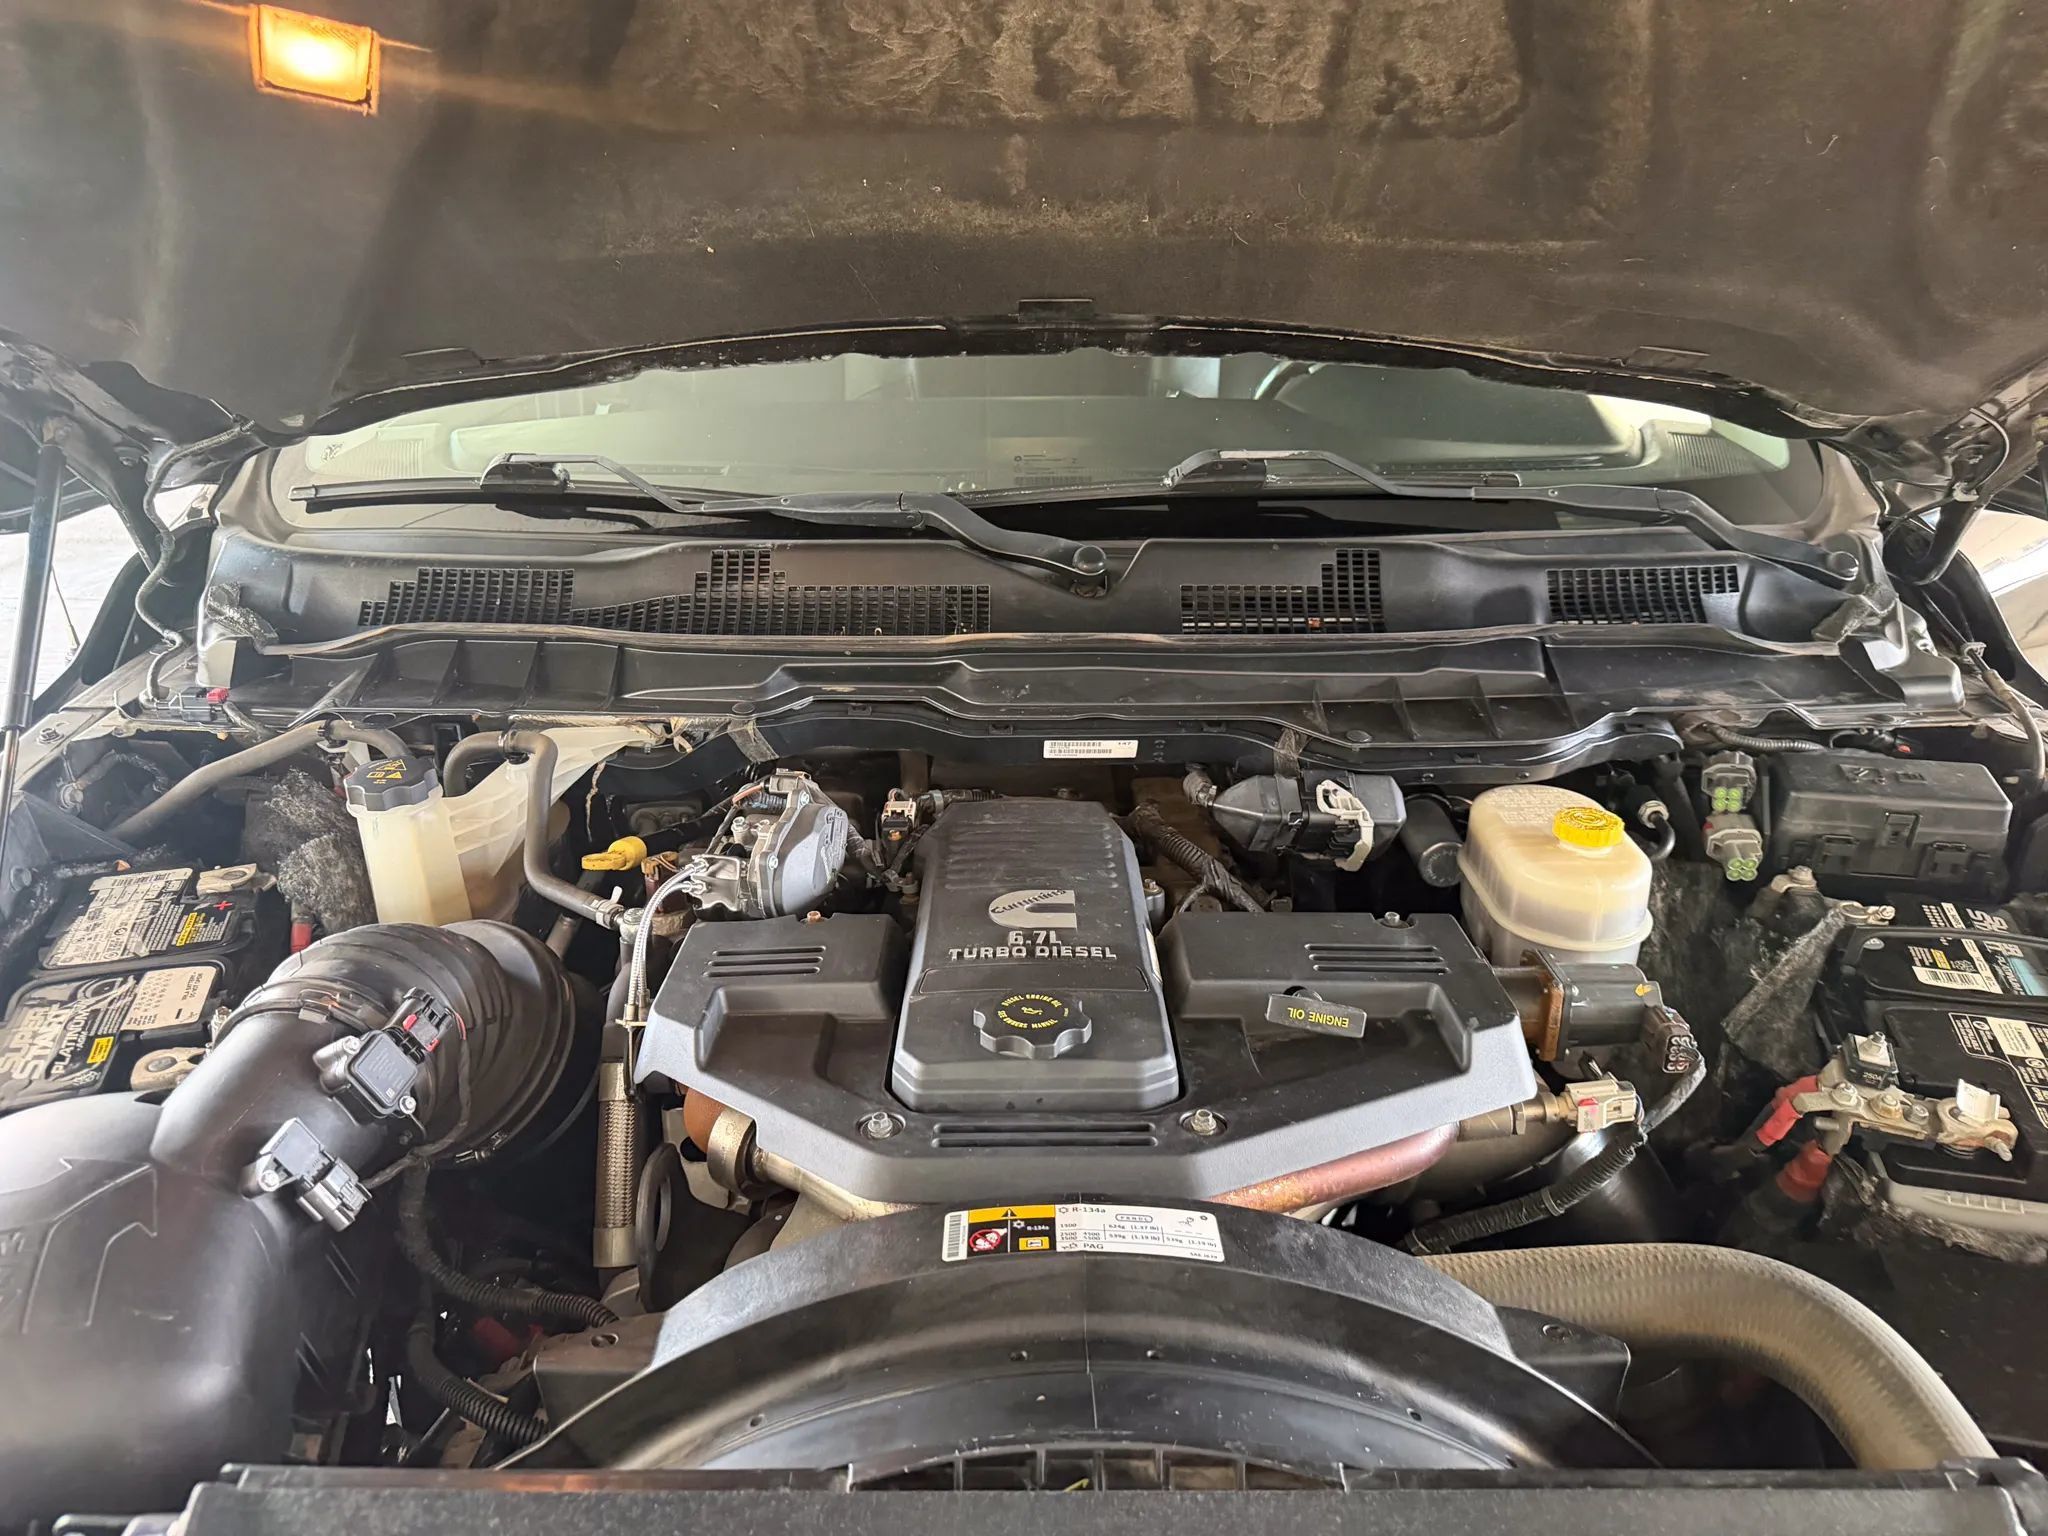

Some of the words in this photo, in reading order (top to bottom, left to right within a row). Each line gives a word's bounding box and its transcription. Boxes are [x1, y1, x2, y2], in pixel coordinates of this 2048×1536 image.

[1008, 930, 1061, 946] 6.7L
[949, 946, 1027, 960] TURBO
[1036, 945, 1117, 959] DIESEL
[1001, 995, 1024, 1007] DIESEL
[1026, 994, 1054, 1002] ENGINE
[1287, 1007, 1305, 1020] OIL
[1308, 1011, 1349, 1028] ENGINE
[51, 1001, 89, 1074] PLATINUM
